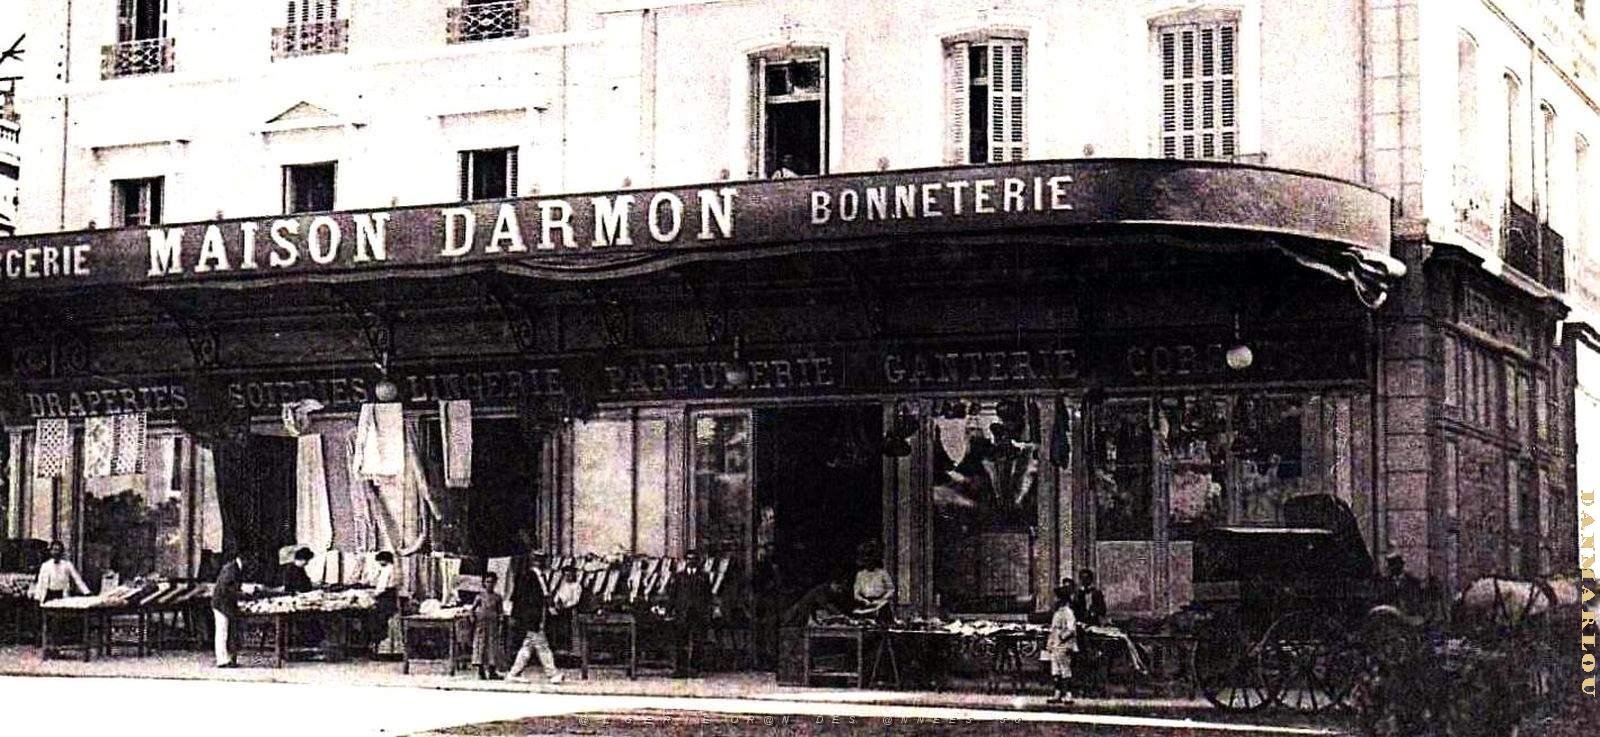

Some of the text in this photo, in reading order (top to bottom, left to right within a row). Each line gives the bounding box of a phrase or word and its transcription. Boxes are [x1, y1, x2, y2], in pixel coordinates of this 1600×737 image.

[810, 174, 1075, 225] BONNETERIE
[146, 187, 738, 277] MAISON DARMON
[0, 244, 91, 279] CERIE
[883, 348, 1077, 384] GANTERIE
[26, 384, 189, 418] DRAPERIES
[405, 367, 565, 403] LINGERIE
